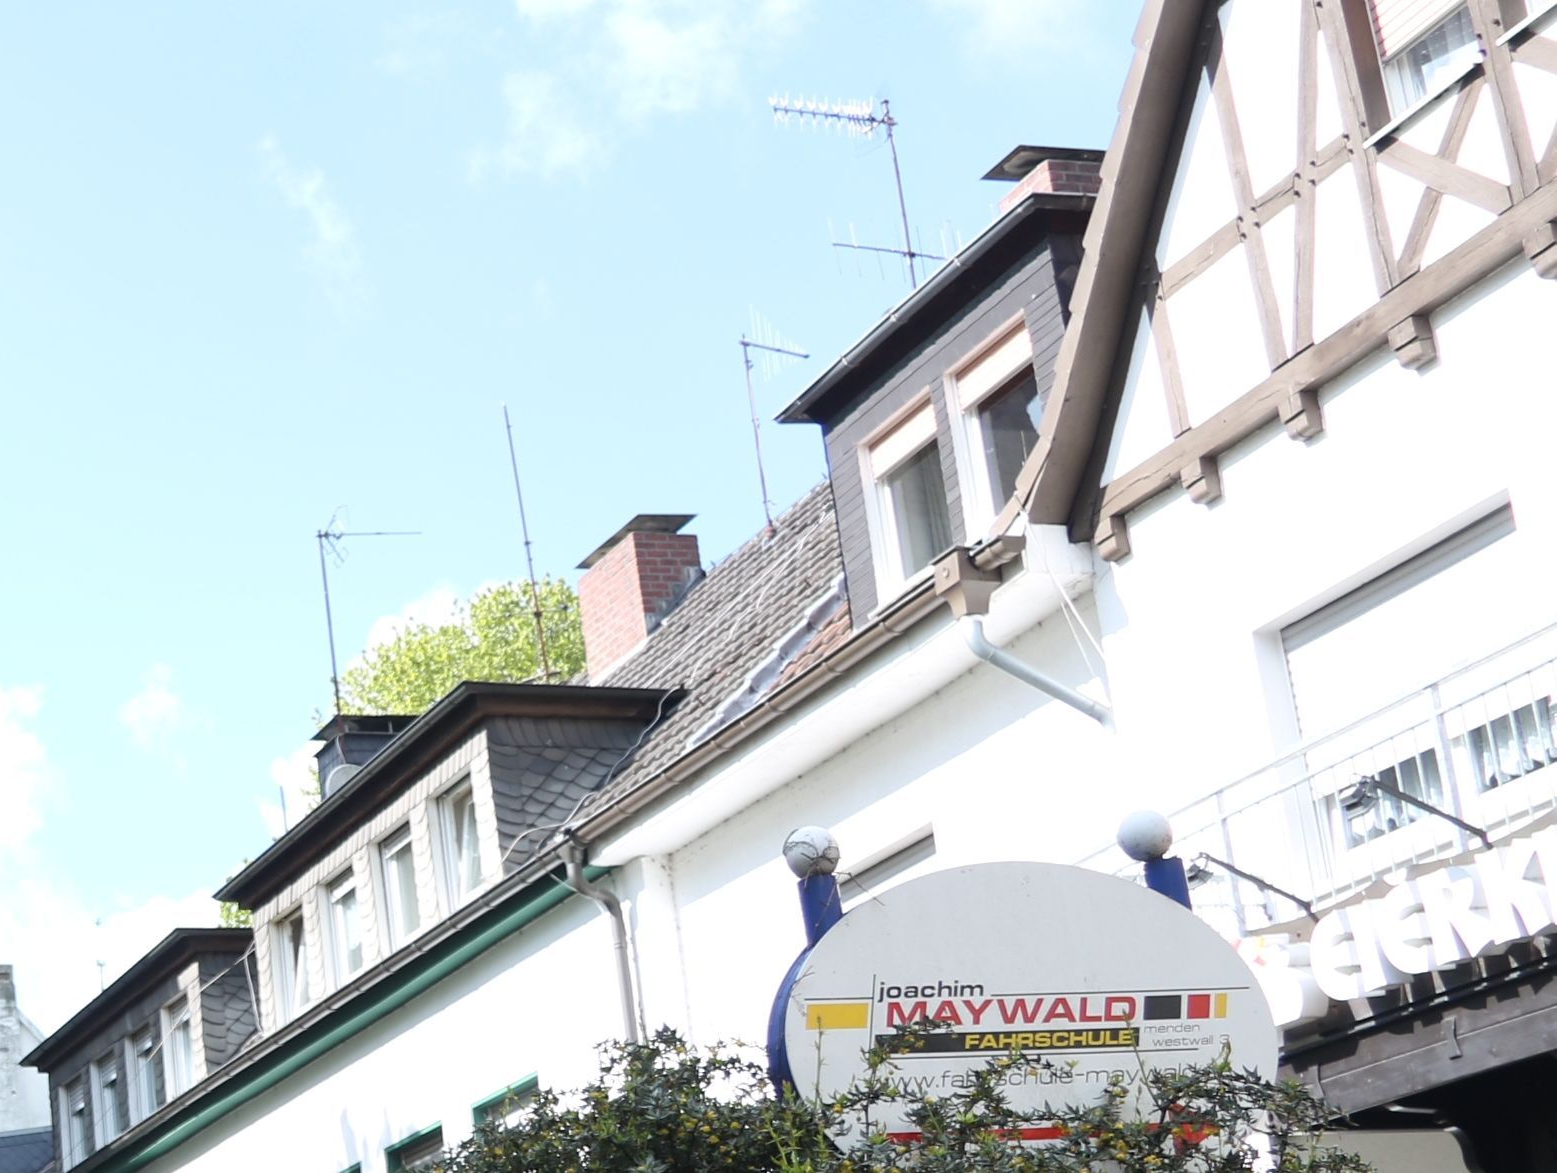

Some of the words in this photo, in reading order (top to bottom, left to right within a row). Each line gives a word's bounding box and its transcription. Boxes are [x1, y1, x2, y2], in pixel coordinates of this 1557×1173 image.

[878, 980, 984, 1002] joachim
[887, 996, 1137, 1028] MAYWALD
[1144, 1022, 1200, 1034] menden
[965, 1029, 1133, 1050] FAHRSCHULE
[1152, 1034, 1213, 1047] westwall
